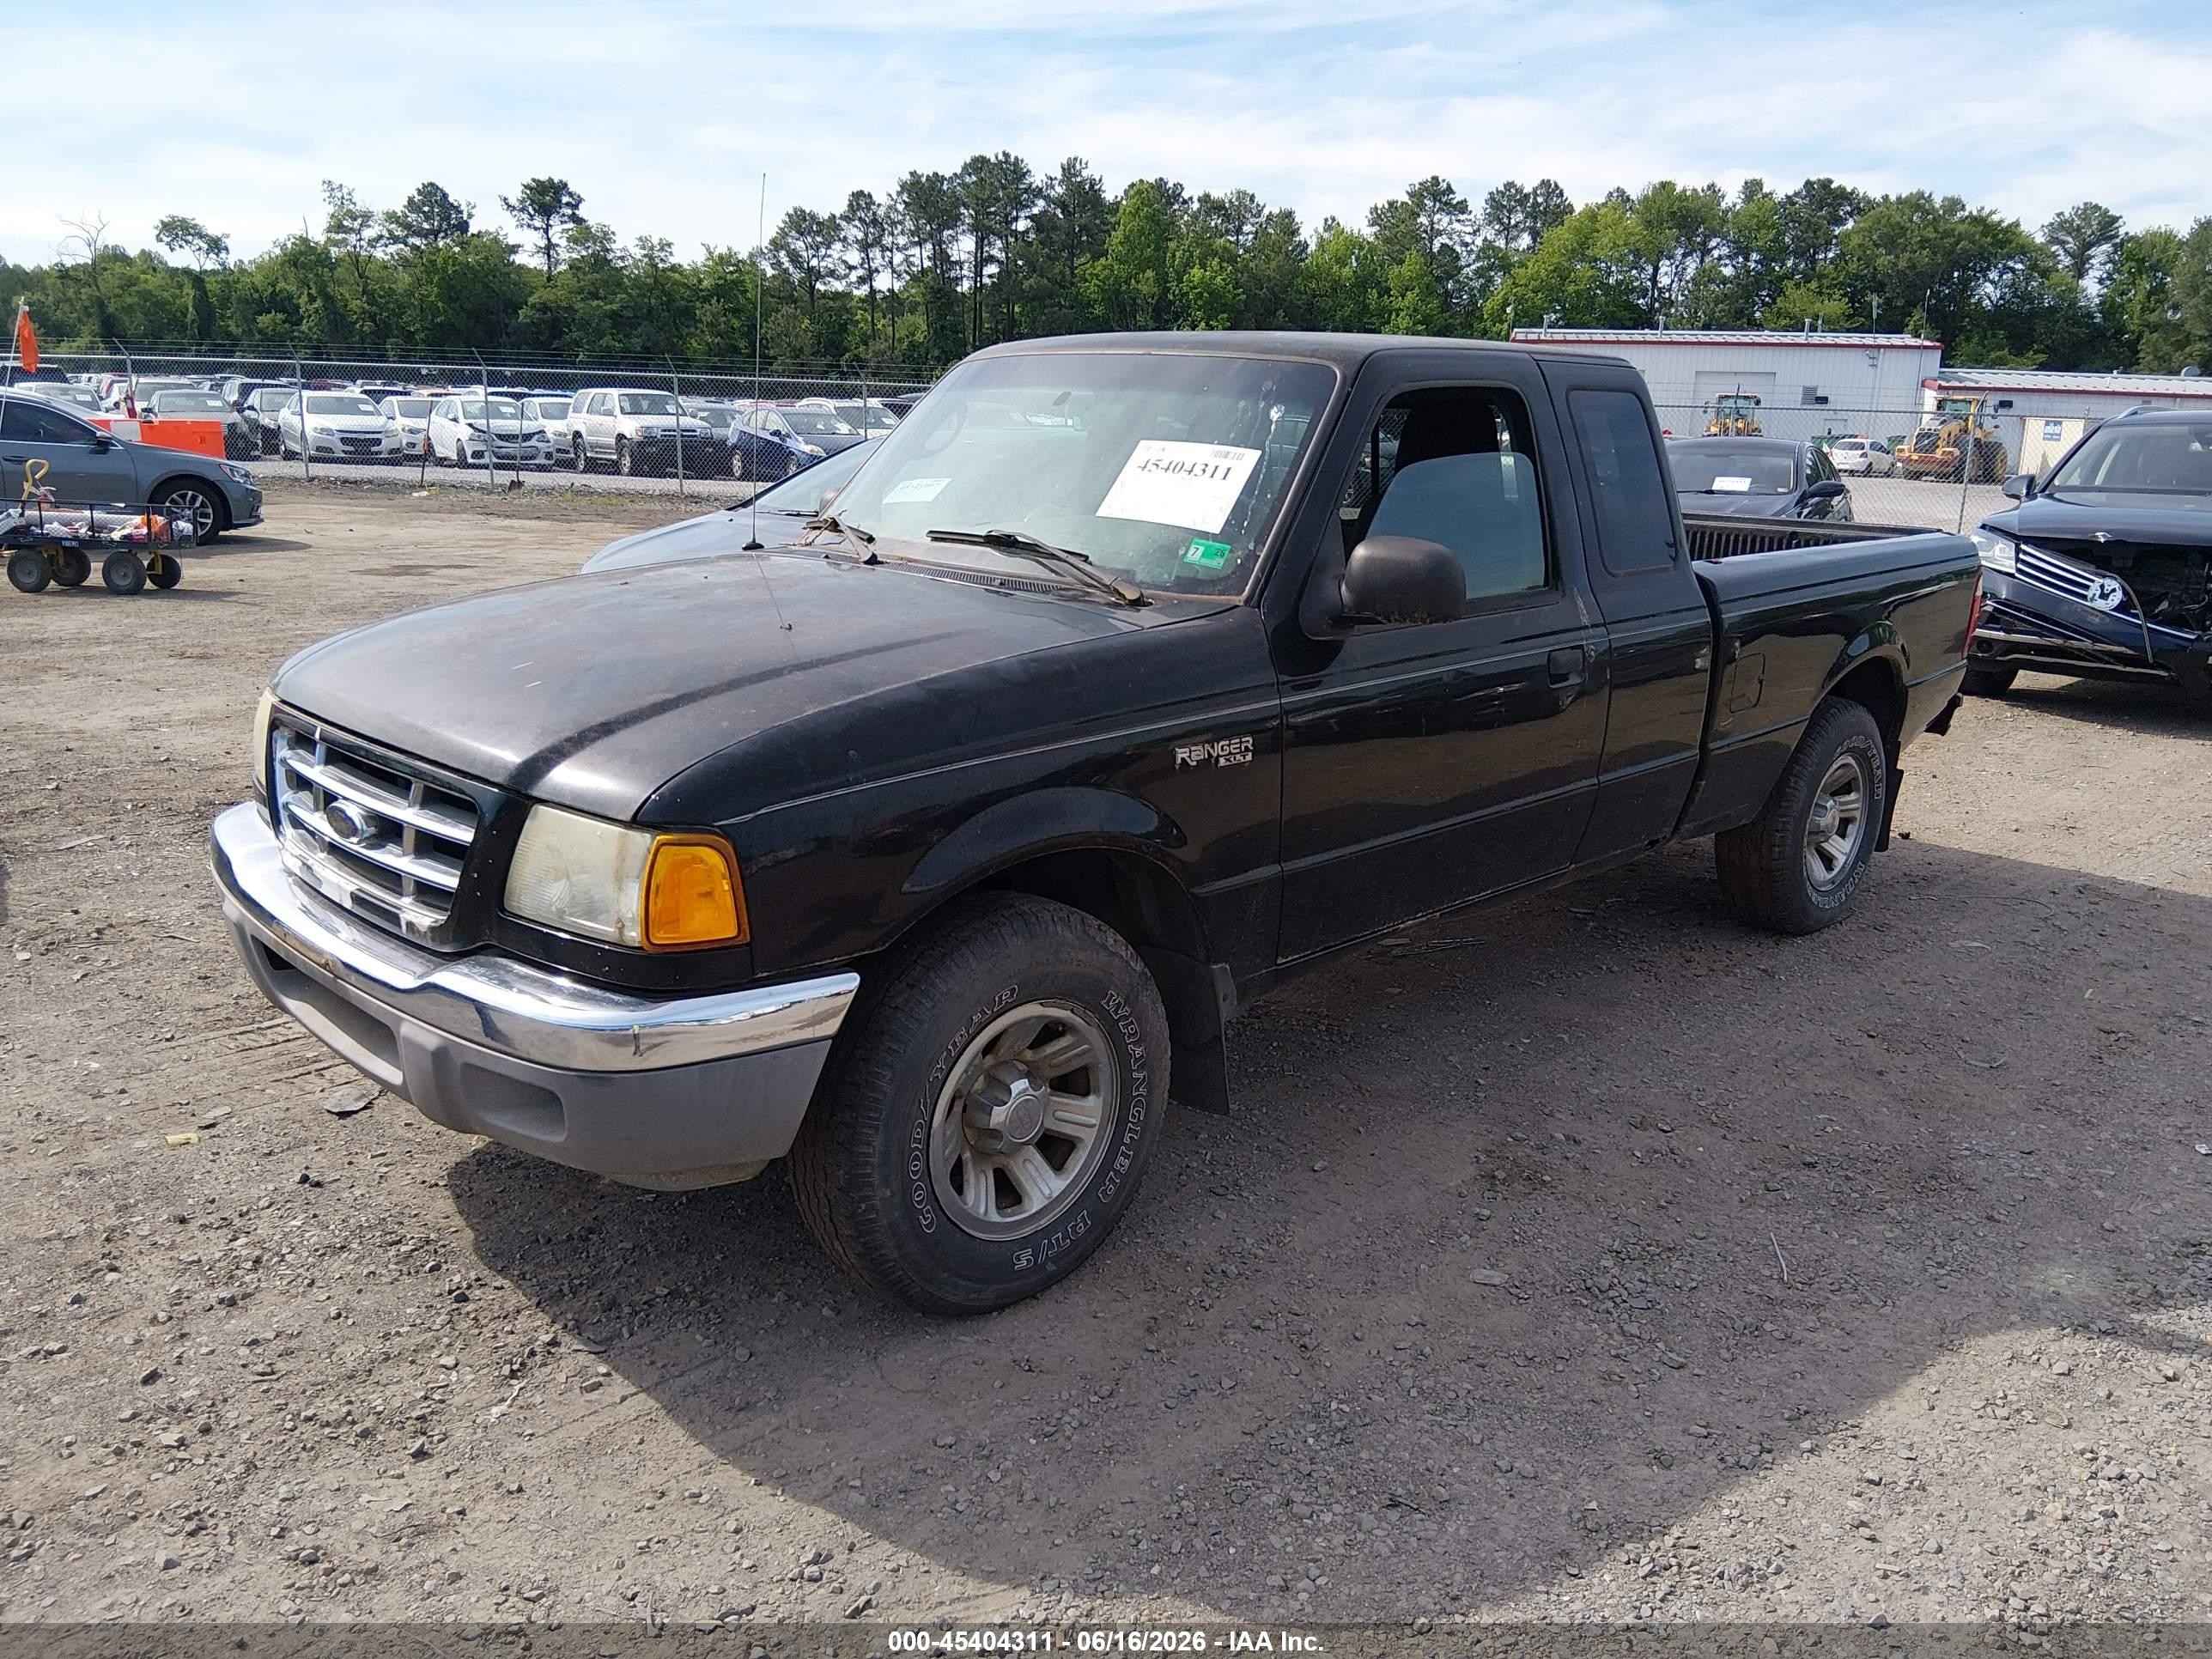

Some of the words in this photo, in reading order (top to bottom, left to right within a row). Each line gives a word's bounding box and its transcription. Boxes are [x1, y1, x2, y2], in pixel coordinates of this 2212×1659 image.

[1138, 458, 1233, 480] 45404311
[1191, 546, 1199, 556] 7
[1222, 753, 1250, 764] XLT
[1099, 990, 1147, 1204] WRANGLER
[1013, 1209, 1092, 1271] RT/S
